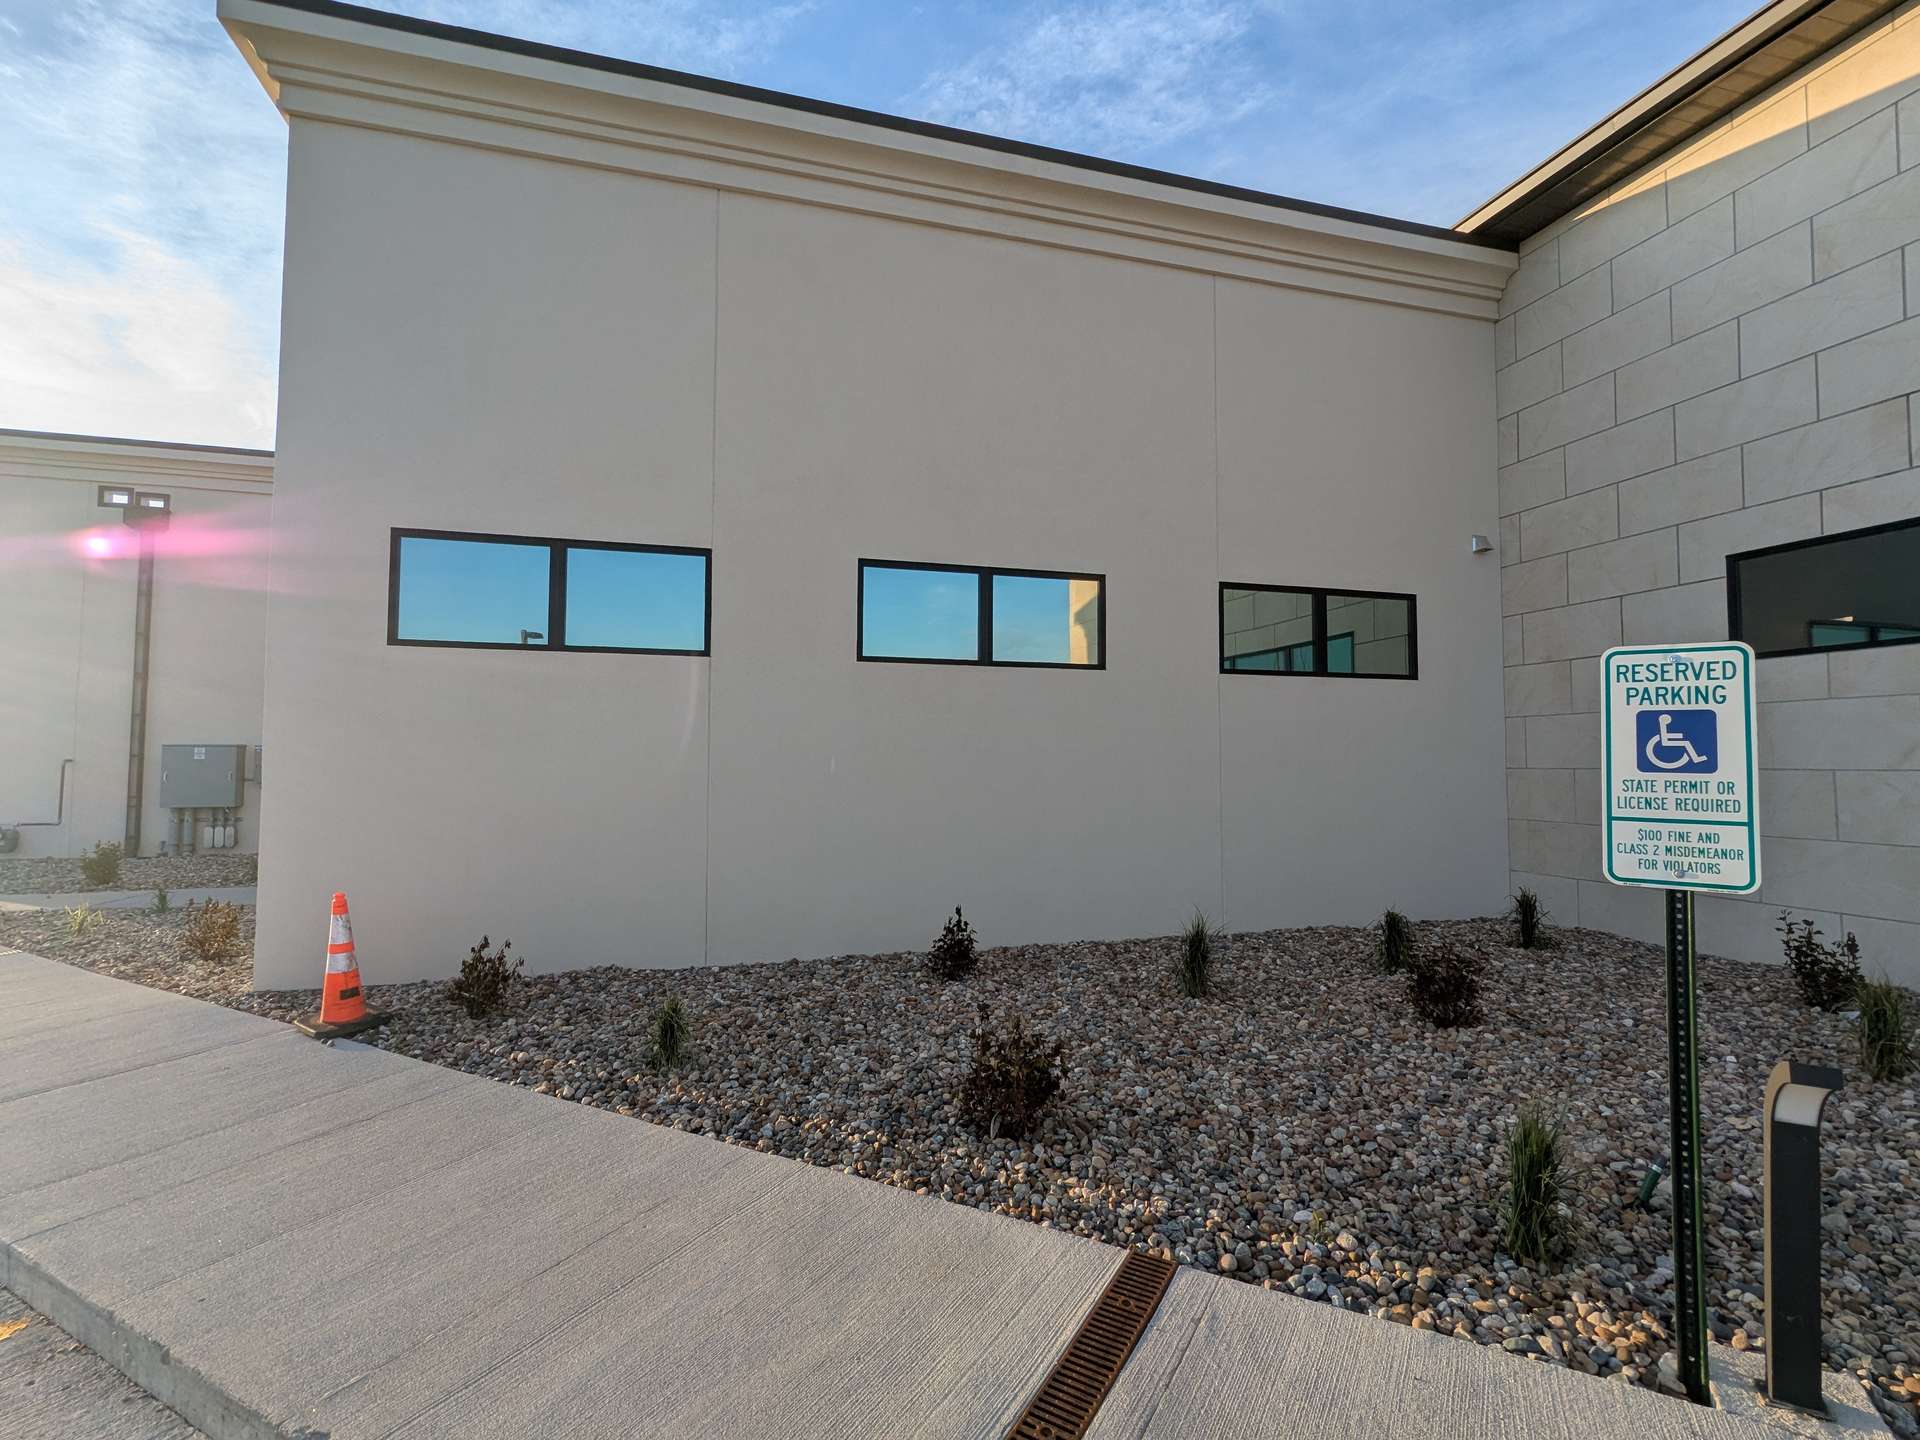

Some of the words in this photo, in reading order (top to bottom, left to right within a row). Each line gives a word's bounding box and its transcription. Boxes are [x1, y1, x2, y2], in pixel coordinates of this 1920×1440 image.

[1616, 660, 1737, 683] RESERVED
[1626, 685, 1727, 706] PARKING
[1622, 779, 1658, 793] STATE
[1664, 780, 1710, 794] PERMIT
[1717, 781, 1735, 795] OR
[1617, 796, 1668, 811] LICENSE
[1675, 798, 1741, 813] REQUIRED
[1638, 828, 1662, 842] $100
[1668, 830, 1692, 843] FINE
[1697, 832, 1720, 844] AND
[1617, 842, 1648, 855] CLASS
[1653, 844, 1659, 856] 2
[1665, 845, 1744, 861] MISDEMEANOR
[1638, 858, 1658, 871] FOR
[1663, 860, 1721, 875] VIOLATORS
